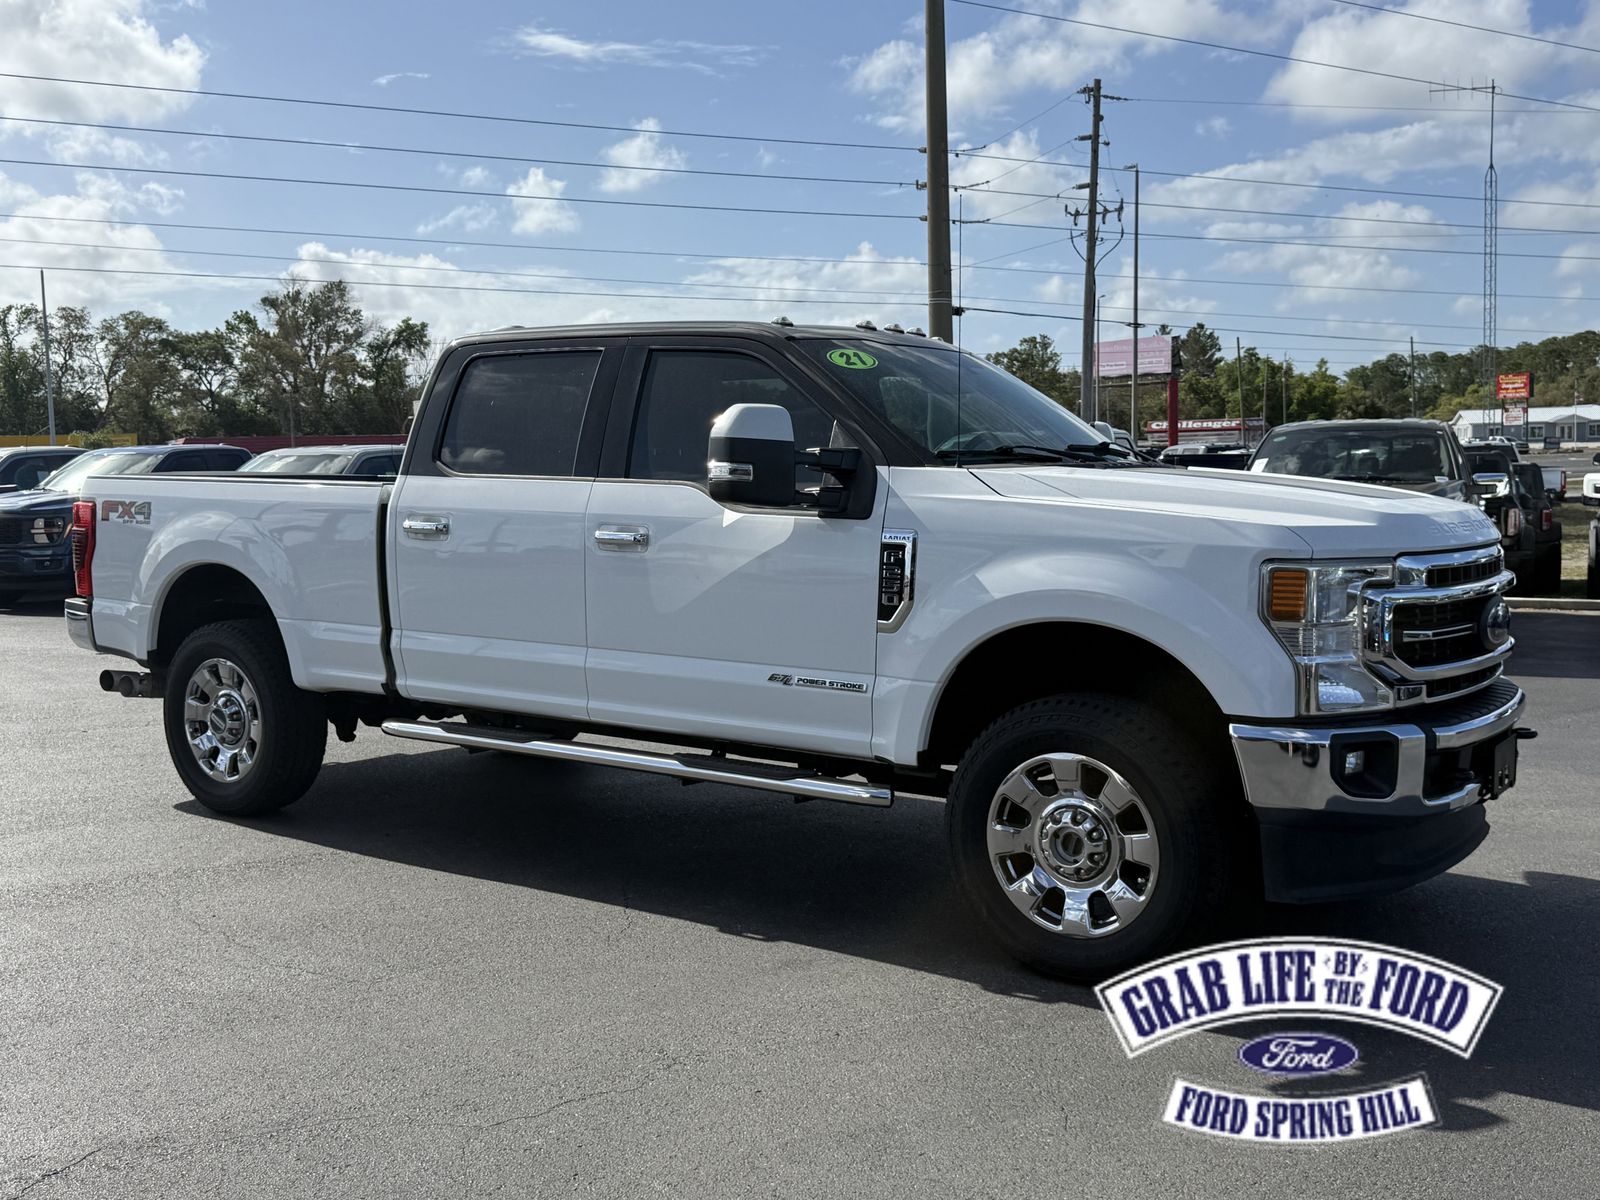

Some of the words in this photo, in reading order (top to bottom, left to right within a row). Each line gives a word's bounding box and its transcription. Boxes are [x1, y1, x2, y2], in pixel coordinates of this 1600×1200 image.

[839, 352, 868, 366] 21
[101, 500, 152, 521] FX4
[797, 677, 826, 686] POWER
[828, 681, 864, 690] STROKE
